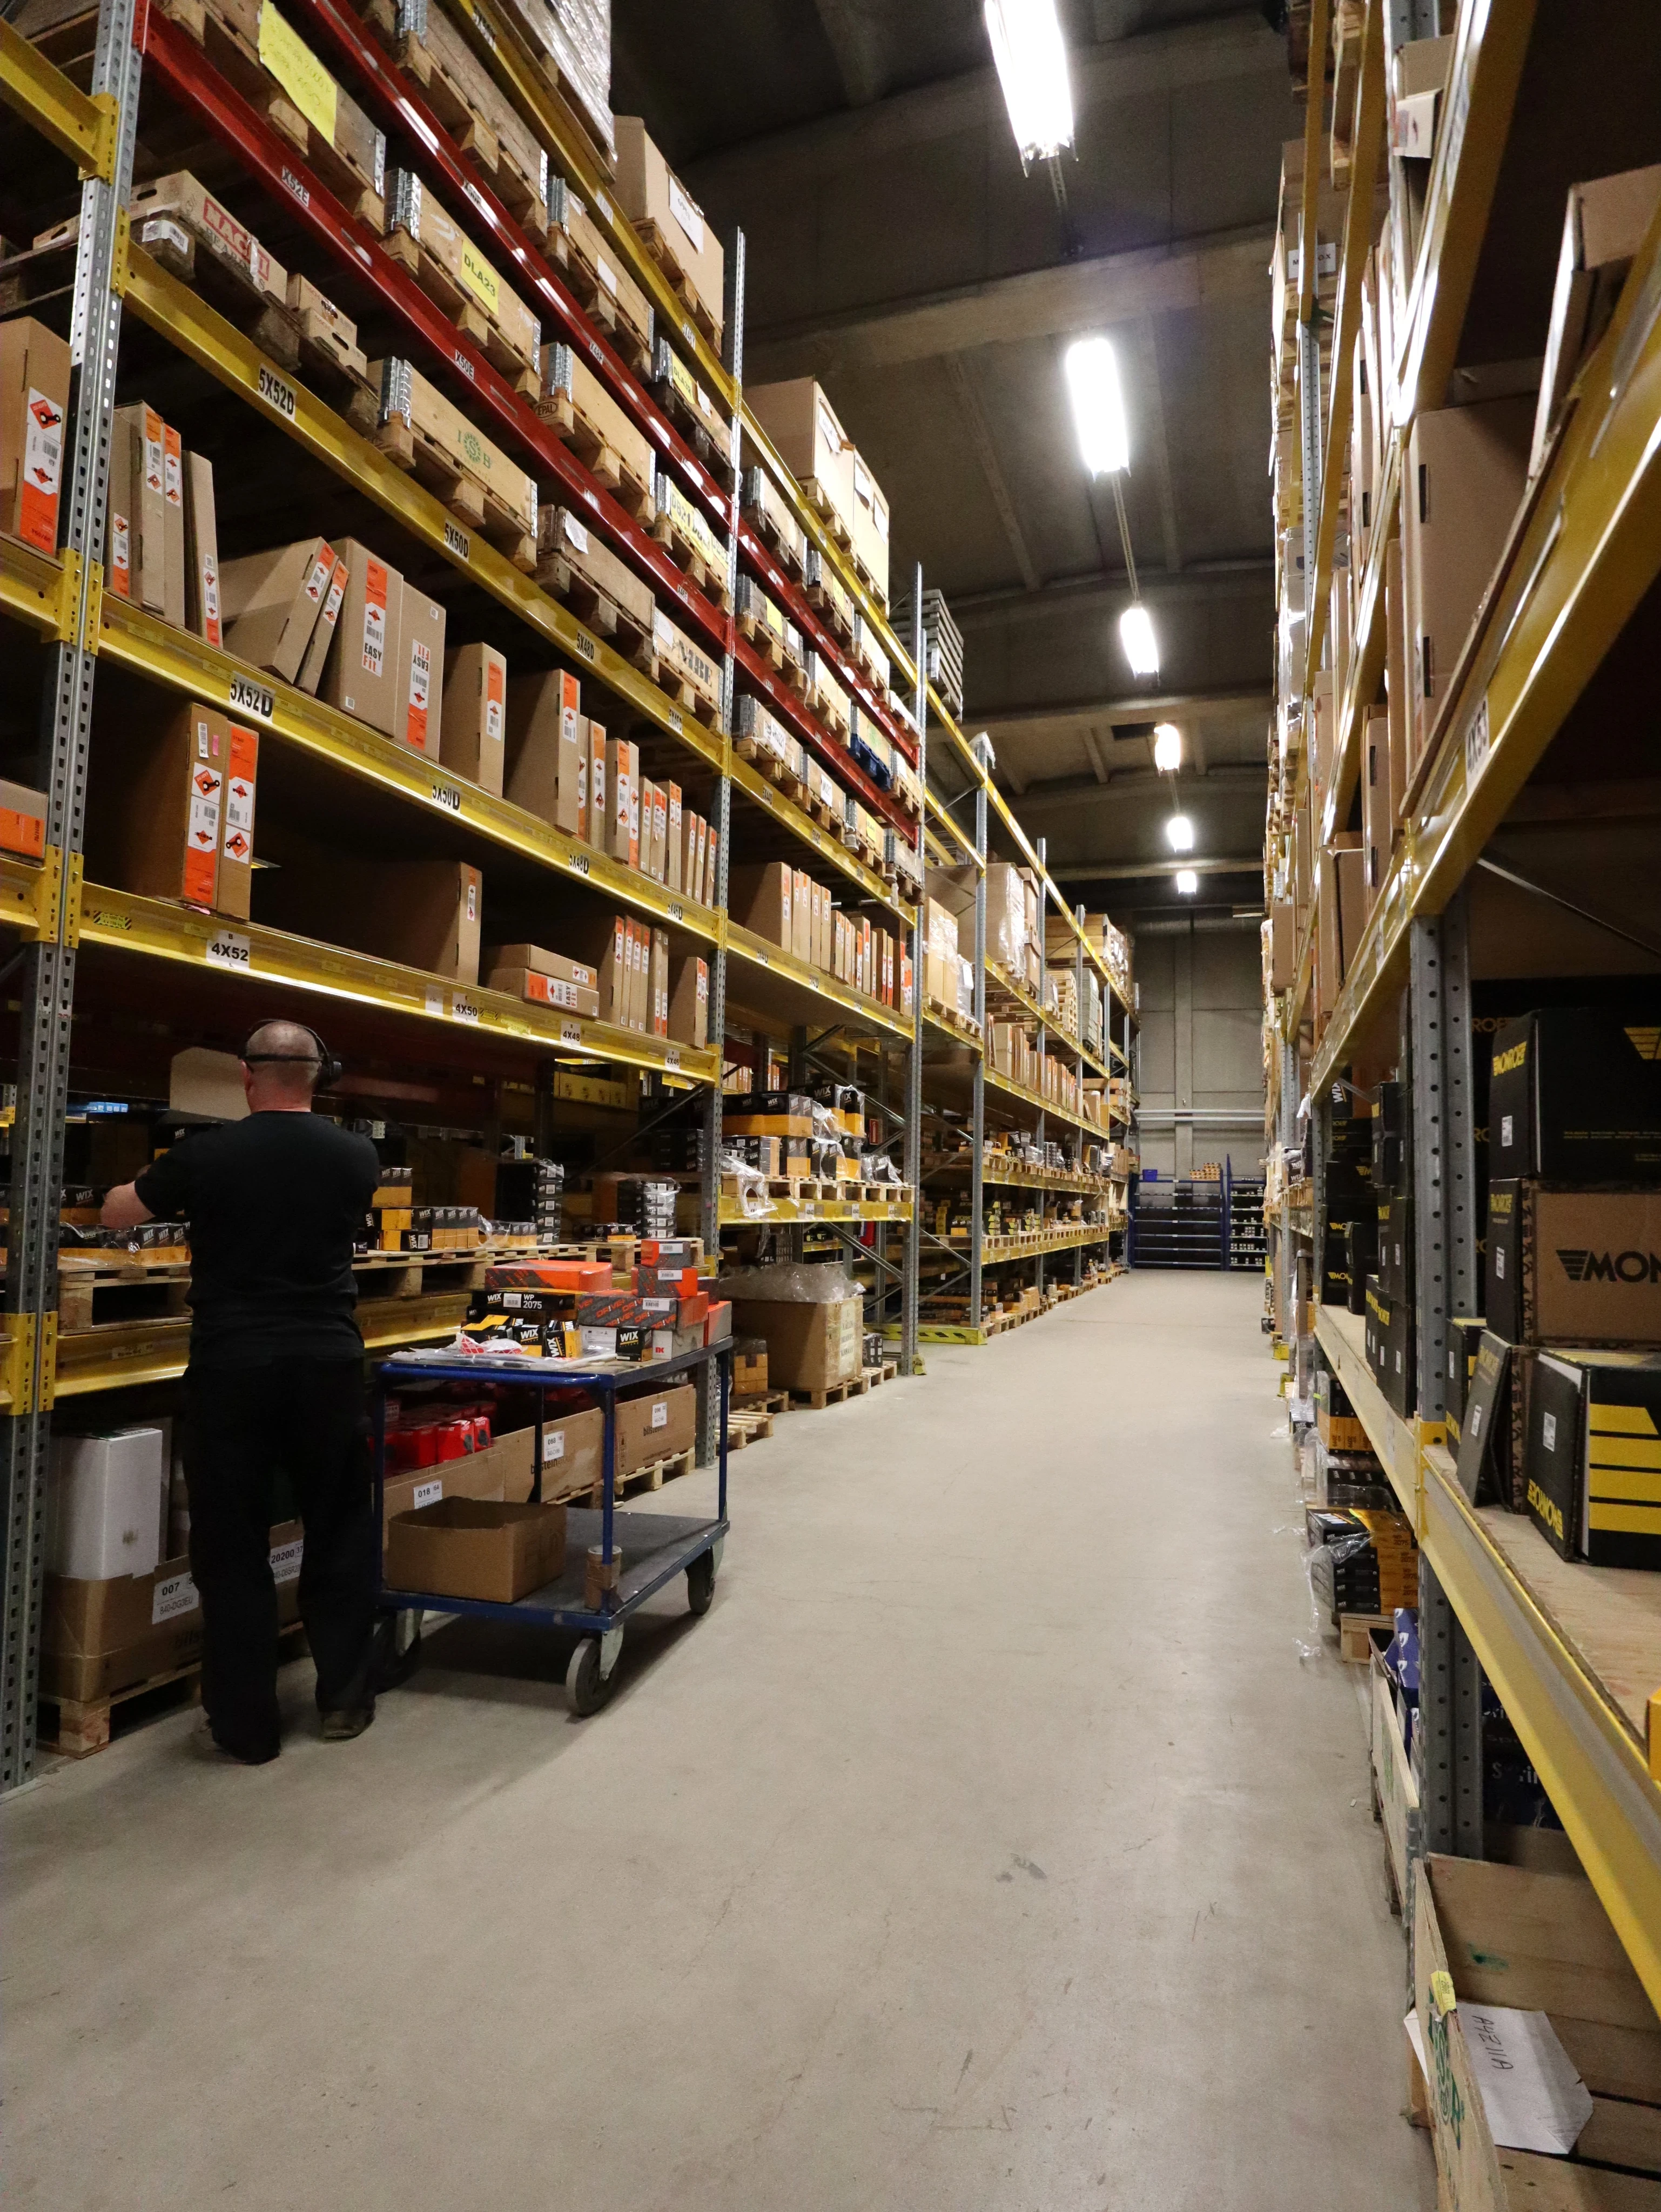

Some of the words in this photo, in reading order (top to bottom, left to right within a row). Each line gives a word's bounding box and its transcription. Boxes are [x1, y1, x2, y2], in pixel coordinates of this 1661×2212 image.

[283, 167, 308, 204] X52E
[204, 197, 269, 281] NACI
[464, 253, 495, 296] DLA23
[455, 352, 474, 377] X50E
[258, 368, 294, 415] 5X52D
[538, 404, 553, 415] EPAL
[444, 522, 469, 558] 5X50D
[365, 642, 382, 662] EASY
[576, 632, 595, 660] 5X48D
[362, 655, 377, 672] Fit
[413, 654, 429, 672] EASY
[231, 679, 274, 718] 5X52D
[433, 785, 460, 810] 5X50D
[212, 943, 248, 961] 4X52
[456, 1003, 478, 1016] 4X50
[563, 1030, 581, 1042] 4X48
[667, 1057, 680, 1066] 4X46
[1493, 1041, 1526, 1076] MONROE
[814, 1086, 831, 1097] WIX
[175, 1128, 185, 1137] WIX
[812, 1141, 820, 1153] WIX
[382, 1168, 391, 1177] WIX
[393, 1169, 401, 1177] WIX
[76, 1189, 93, 1201] WIX
[419, 1209, 432, 1218] WIX
[435, 1209, 445, 1218] WIX
[448, 1209, 456, 1218] WIX
[459, 1209, 467, 1218] WIX
[470, 1209, 478, 1218] WIX
[143, 1228, 154, 1239] WIX
[159, 1228, 170, 1238] WIX
[173, 1228, 184, 1239] WIX
[624, 1226, 633, 1234] WIX
[410, 1235, 418, 1249] WIX
[487, 1293, 501, 1302] WIX
[523, 1301, 542, 1309] 2075
[520, 1328, 539, 1339] WIX
[620, 1331, 638, 1341] WIX
[546, 1338, 560, 1358] WIX
[418, 1487, 431, 1498] 018
[1526, 1478, 1564, 1540] MONROE
[162, 1582, 180, 1596] 007
